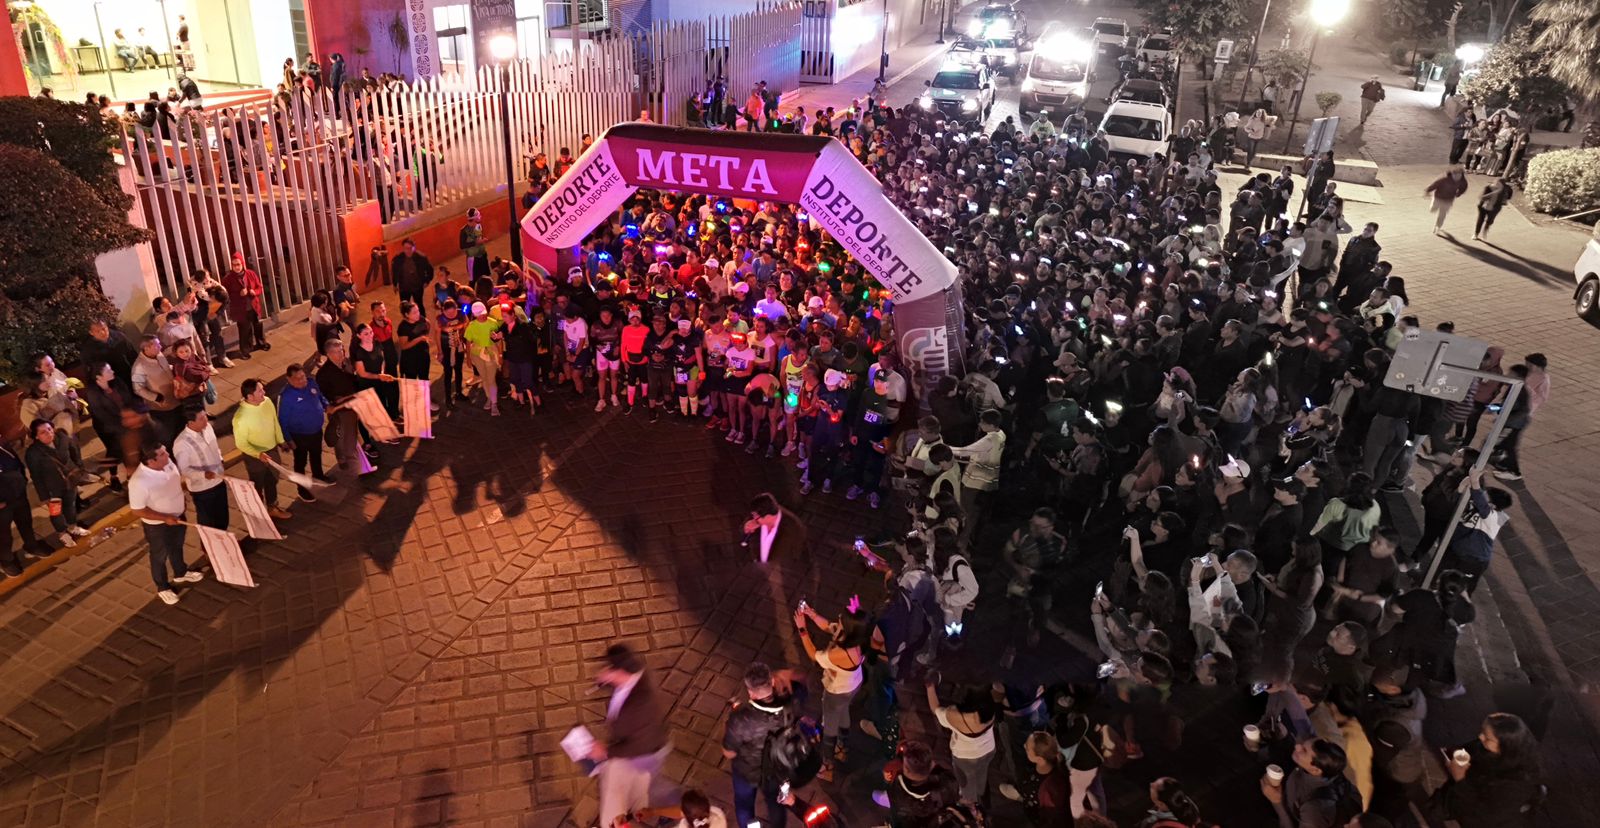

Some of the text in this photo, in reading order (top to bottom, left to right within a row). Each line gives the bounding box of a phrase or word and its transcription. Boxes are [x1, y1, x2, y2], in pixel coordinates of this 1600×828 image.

[532, 153, 611, 236] DEPORTE
[636, 148, 779, 195] META
[545, 172, 620, 244] INSTITUTO DEL DEPORTE
[802, 193, 846, 237] INSTITUTO
[844, 235, 862, 255] DEL
[810, 174, 923, 295] DEPORTE
